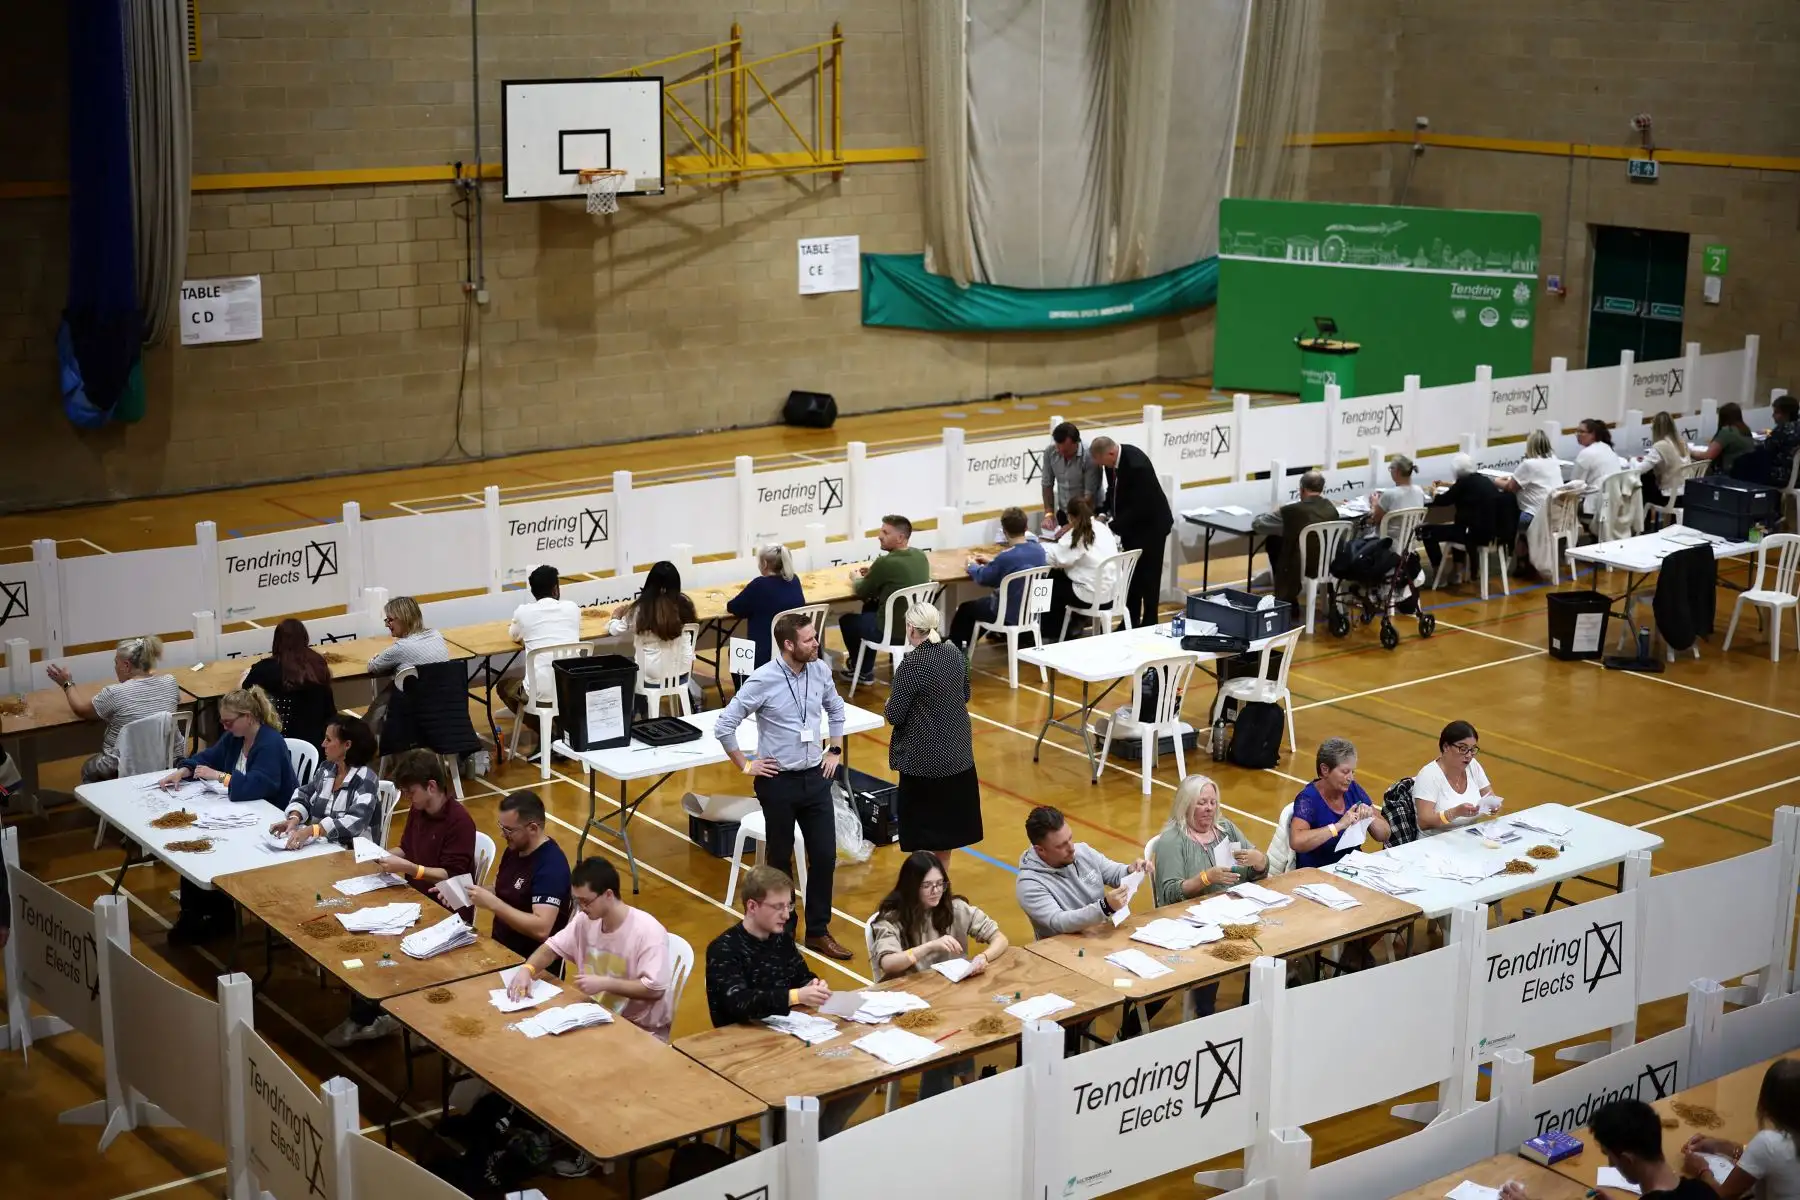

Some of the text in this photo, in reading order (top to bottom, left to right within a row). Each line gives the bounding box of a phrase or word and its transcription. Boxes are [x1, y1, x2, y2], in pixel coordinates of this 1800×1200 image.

[800, 244, 830, 255] TABLE
[808, 265, 824, 276] C E
[1711, 256, 1721, 272] 2
[181, 286, 221, 300] TABLE
[1450, 282, 1502, 299] Tendring
[192, 311, 214, 324] C D
[1633, 372, 1668, 386] Tendring
[1492, 388, 1531, 403] Tendring
[1342, 408, 1384, 425] Tendring
[1164, 430, 1210, 447] Tendring
[1181, 447, 1207, 460] Elects
[967, 453, 1021, 472] Tendring
[988, 472, 1018, 486] Elects
[757, 482, 817, 503] Tendring
[780, 502, 813, 517] Elects
[508, 514, 577, 536] Tendring
[536, 535, 574, 551] Elects
[225, 549, 303, 574] Tendring
[258, 570, 300, 588] Elects
[1034, 586, 1048, 597] CD
[735, 647, 754, 660] CC
[18, 894, 81, 960] Tendring
[45, 945, 80, 984] Elects
[1487, 938, 1581, 982] Tendring
[1522, 972, 1575, 1003] Elects
[1073, 1058, 1192, 1115] Tendring
[248, 1057, 301, 1144] Tendring
[1119, 1097, 1184, 1135] Elects
[270, 1120, 300, 1171] Elects
